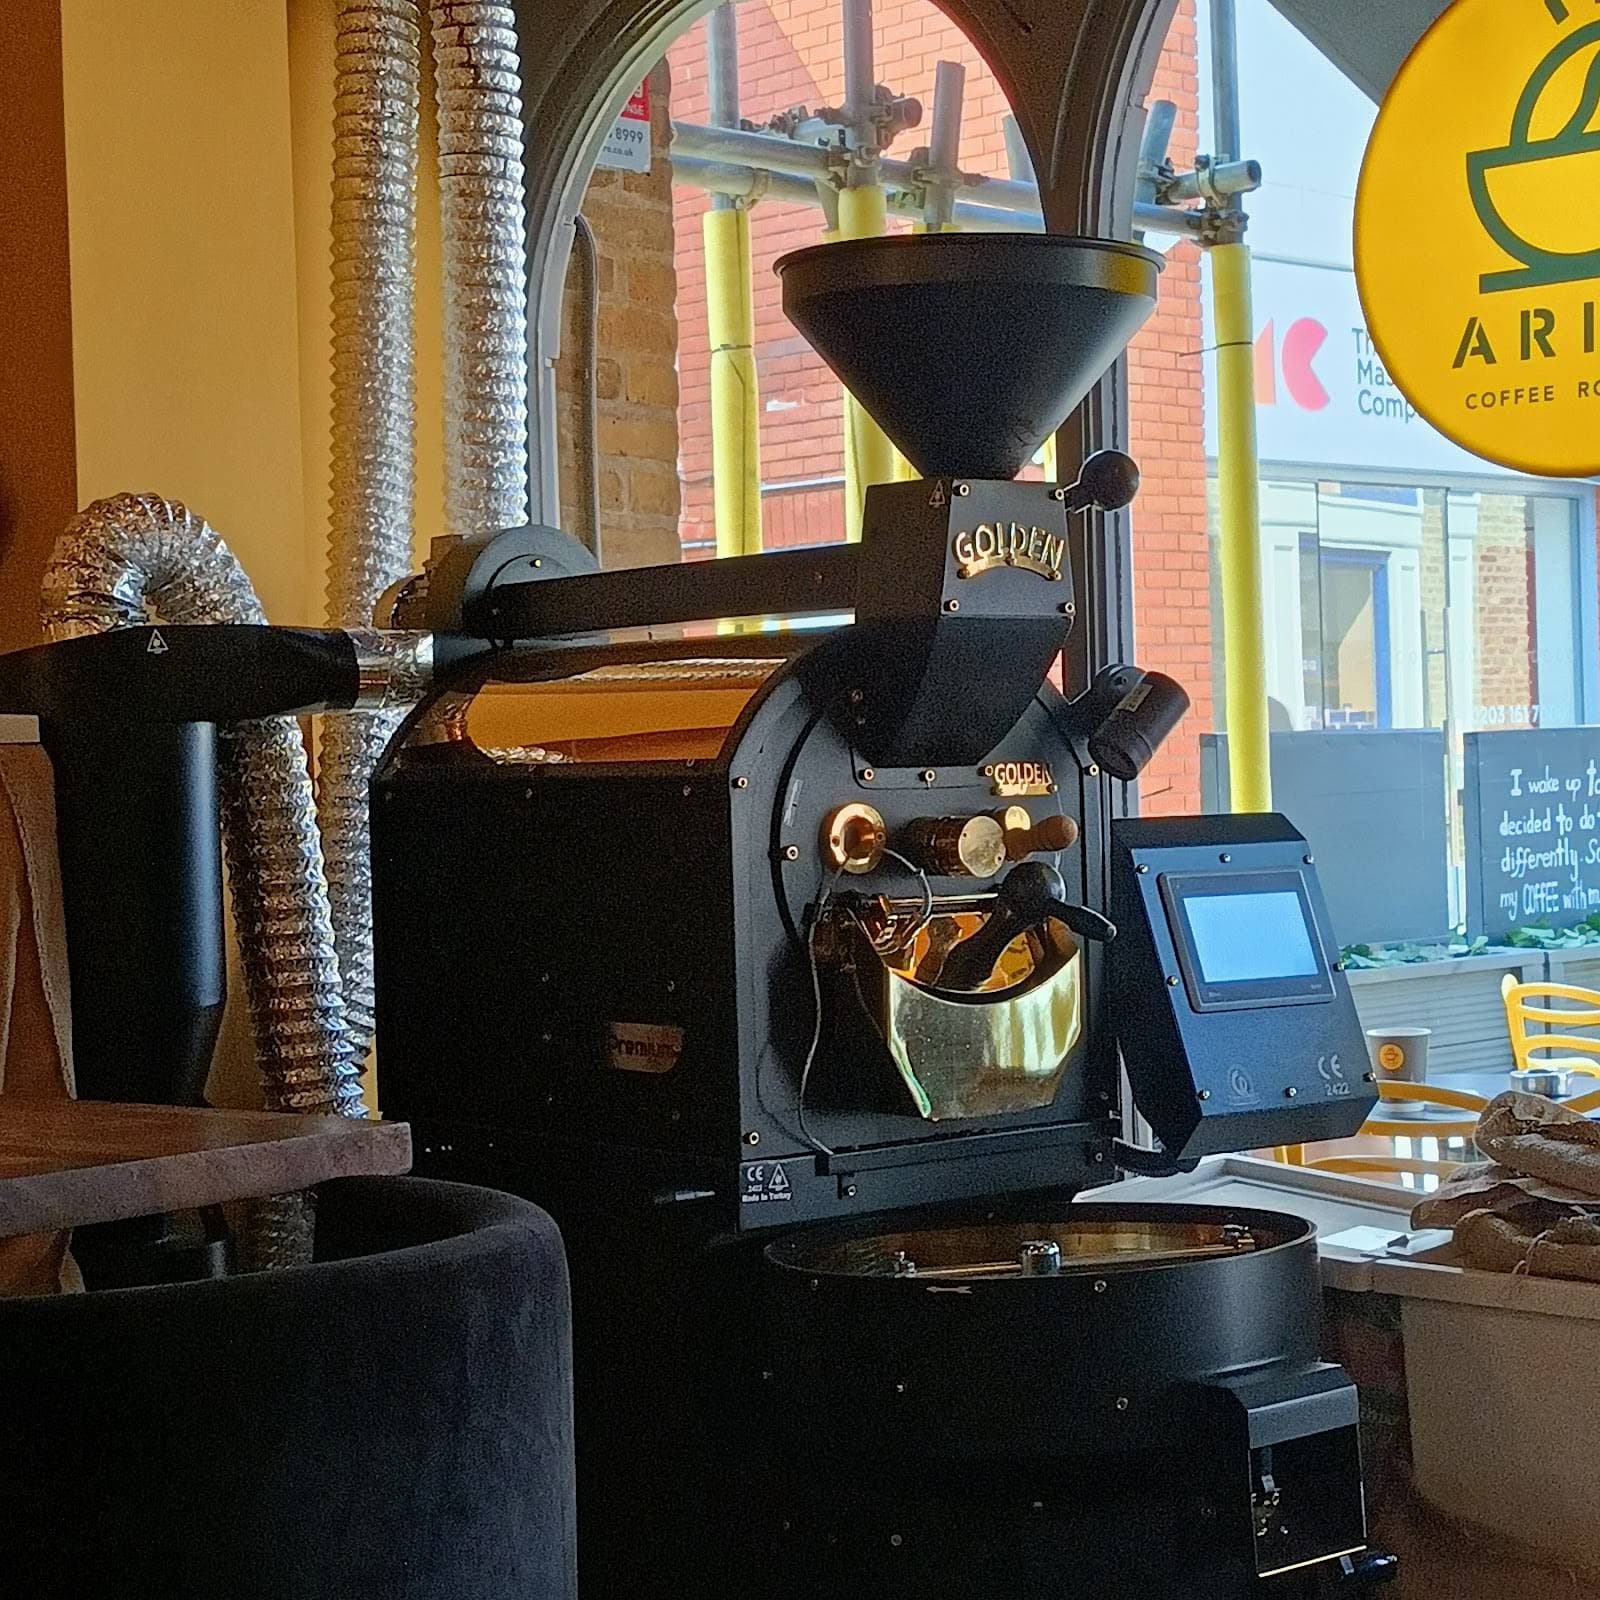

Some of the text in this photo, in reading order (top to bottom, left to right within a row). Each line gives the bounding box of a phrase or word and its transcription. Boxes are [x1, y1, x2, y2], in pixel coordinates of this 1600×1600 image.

[615, 127, 644, 143] 8999
[1465, 384, 1556, 410] COFFEE
[954, 521, 1065, 573] GOLDEN
[994, 762, 1053, 786] GOLDEN
[1510, 768, 1523, 797] I
[1528, 764, 1560, 794] wake
[1565, 777, 1582, 803] up
[1499, 802, 1596, 837] decided to do
[1500, 890, 1518, 922] my
[1318, 1053, 1344, 1080] CE
[747, 1165, 764, 1182] CE
